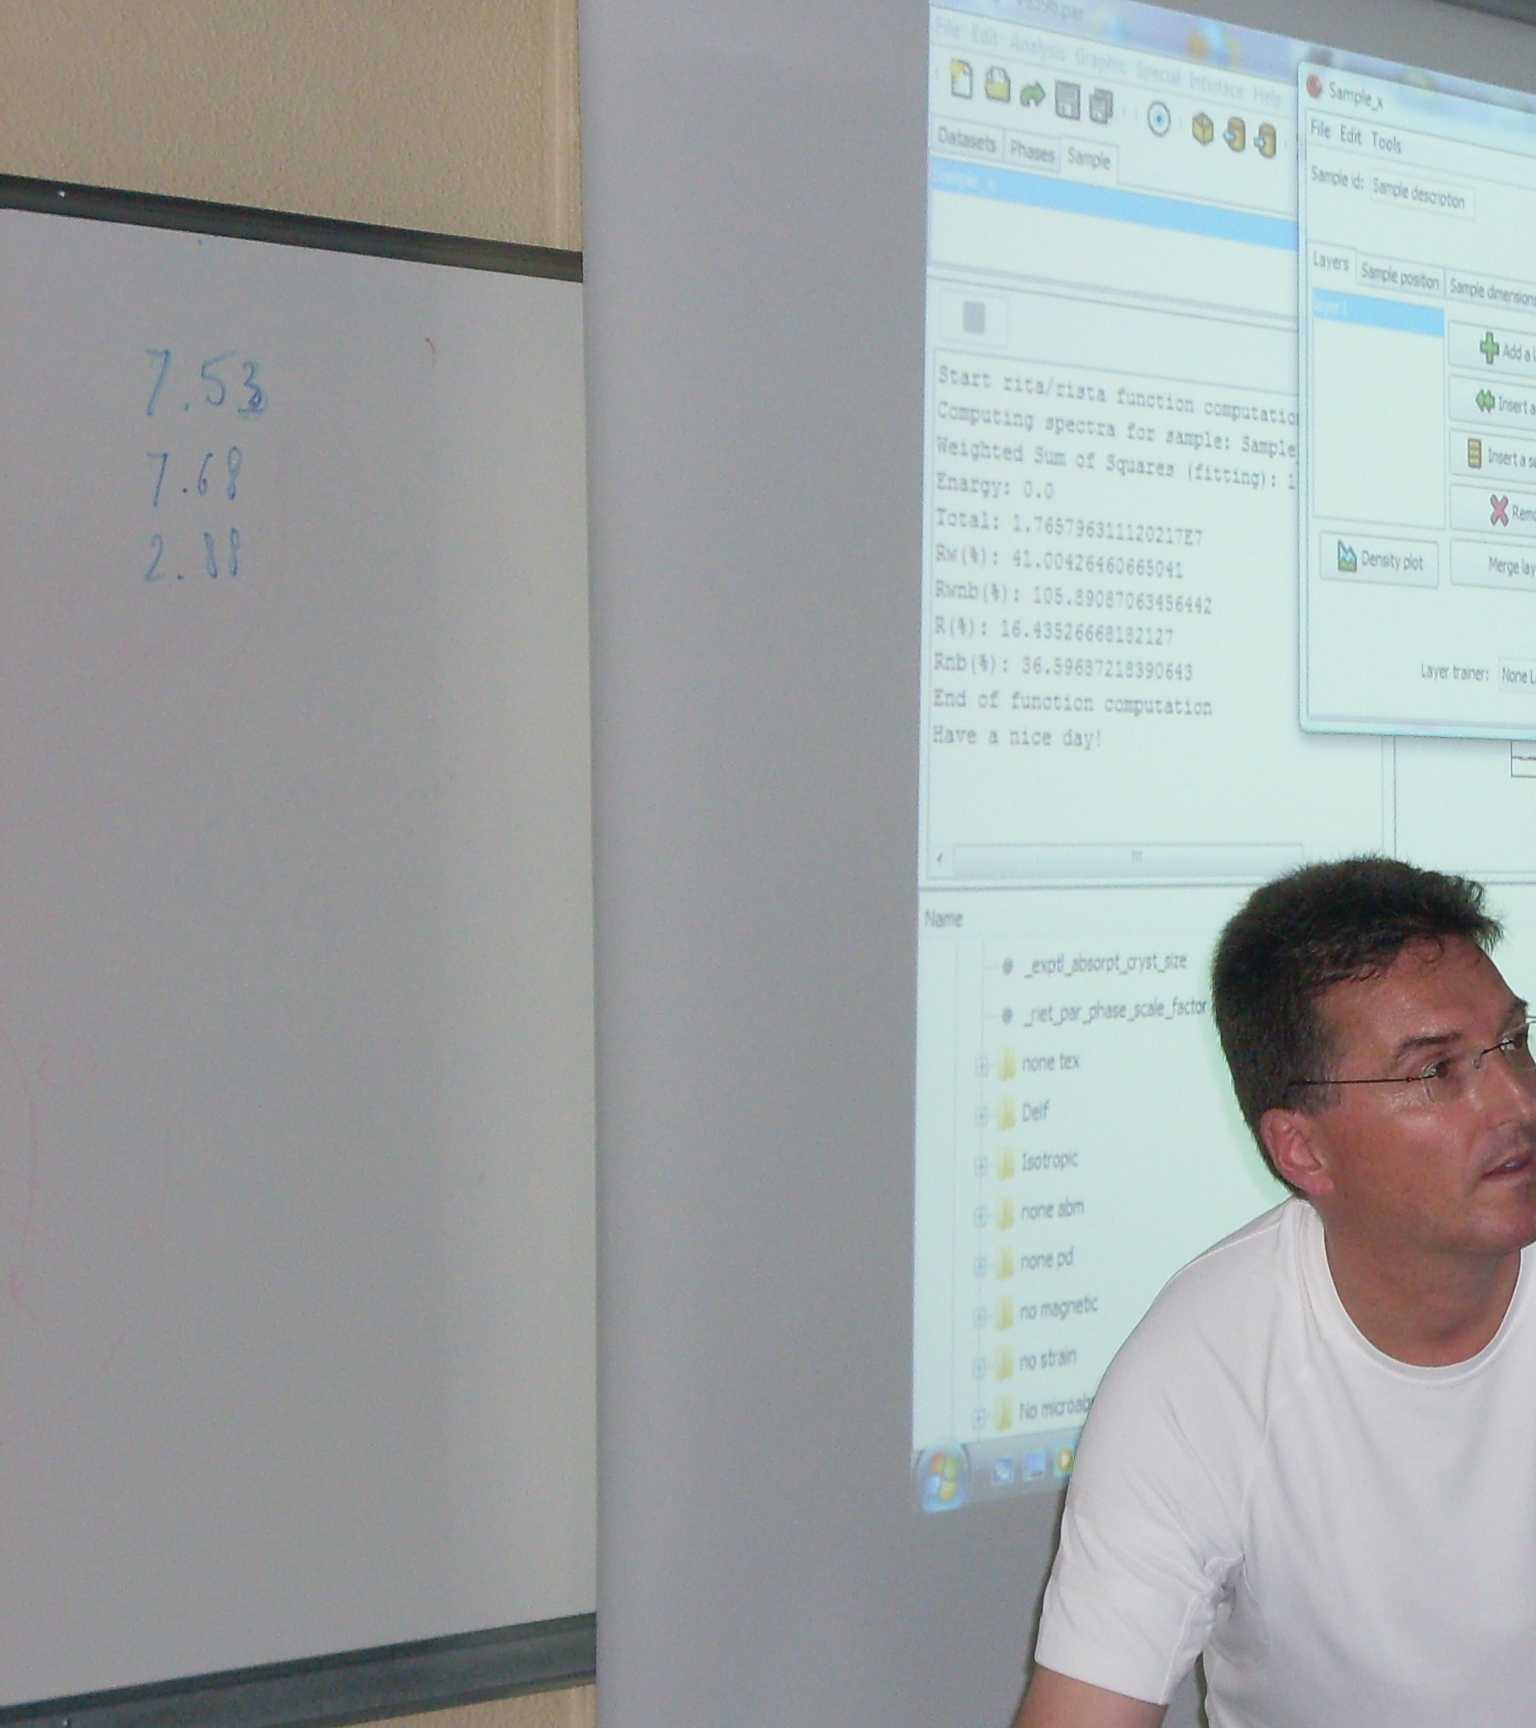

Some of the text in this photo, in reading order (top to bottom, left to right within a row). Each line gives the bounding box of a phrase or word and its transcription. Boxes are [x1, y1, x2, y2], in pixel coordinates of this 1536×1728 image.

[1329, 82, 1383, 112] Sample_x
[938, 126, 996, 154] Datasets
[1311, 119, 1402, 154] File Edit Tools
[1010, 138, 1055, 163] Phases
[1067, 147, 1111, 170] Sample
[1311, 165, 1364, 190] Sample id:
[1373, 177, 1465, 209] Sample description
[1313, 251, 1349, 273] Layers
[1361, 263, 1440, 290] Sample position
[1450, 277, 1484, 300] Sample
[1503, 343, 1522, 361] Add
[938, 365, 992, 389] Start
[1004, 374, 1107, 404] rita/rista
[1116, 387, 1194, 415] function
[1498, 395, 1528, 414] Insert
[938, 401, 1035, 432] Computing
[1045, 415, 1115, 437] spectra
[1127, 422, 1156, 443] for
[1166, 426, 1231, 452] sample:
[937, 436, 1024, 463] Weighted
[1033, 445, 1067, 467] Sum
[1075, 451, 1097, 470] of
[1106, 453, 1175, 478] Squares
[1187, 460, 1276, 491] (fitting):
[1488, 448, 1517, 467] Insert
[146, 446, 241, 507] 7.68
[936, 472, 1055, 500] Energy: 0.0
[936, 507, 1000, 531] Total:
[1361, 550, 1424, 571] Density plot
[1489, 556, 1519, 577] Merge
[934, 616, 988, 638] R(%):
[1421, 661, 1489, 681] Layer trainer:
[1502, 667, 1527, 684] None
[933, 688, 1213, 717] End of function computation
[933, 724, 1102, 751] Have a nice day!
[925, 909, 964, 928] Name
[1022, 1052, 1080, 1072] none tex
[1022, 1150, 1080, 1173] Isotropic
[1021, 1195, 1085, 1221] none abm
[1021, 1254, 1055, 1271] none
[1019, 1297, 1098, 1321] no magnetic
[1019, 1349, 1077, 1371] no strain
[1019, 1403, 1037, 1421] No
